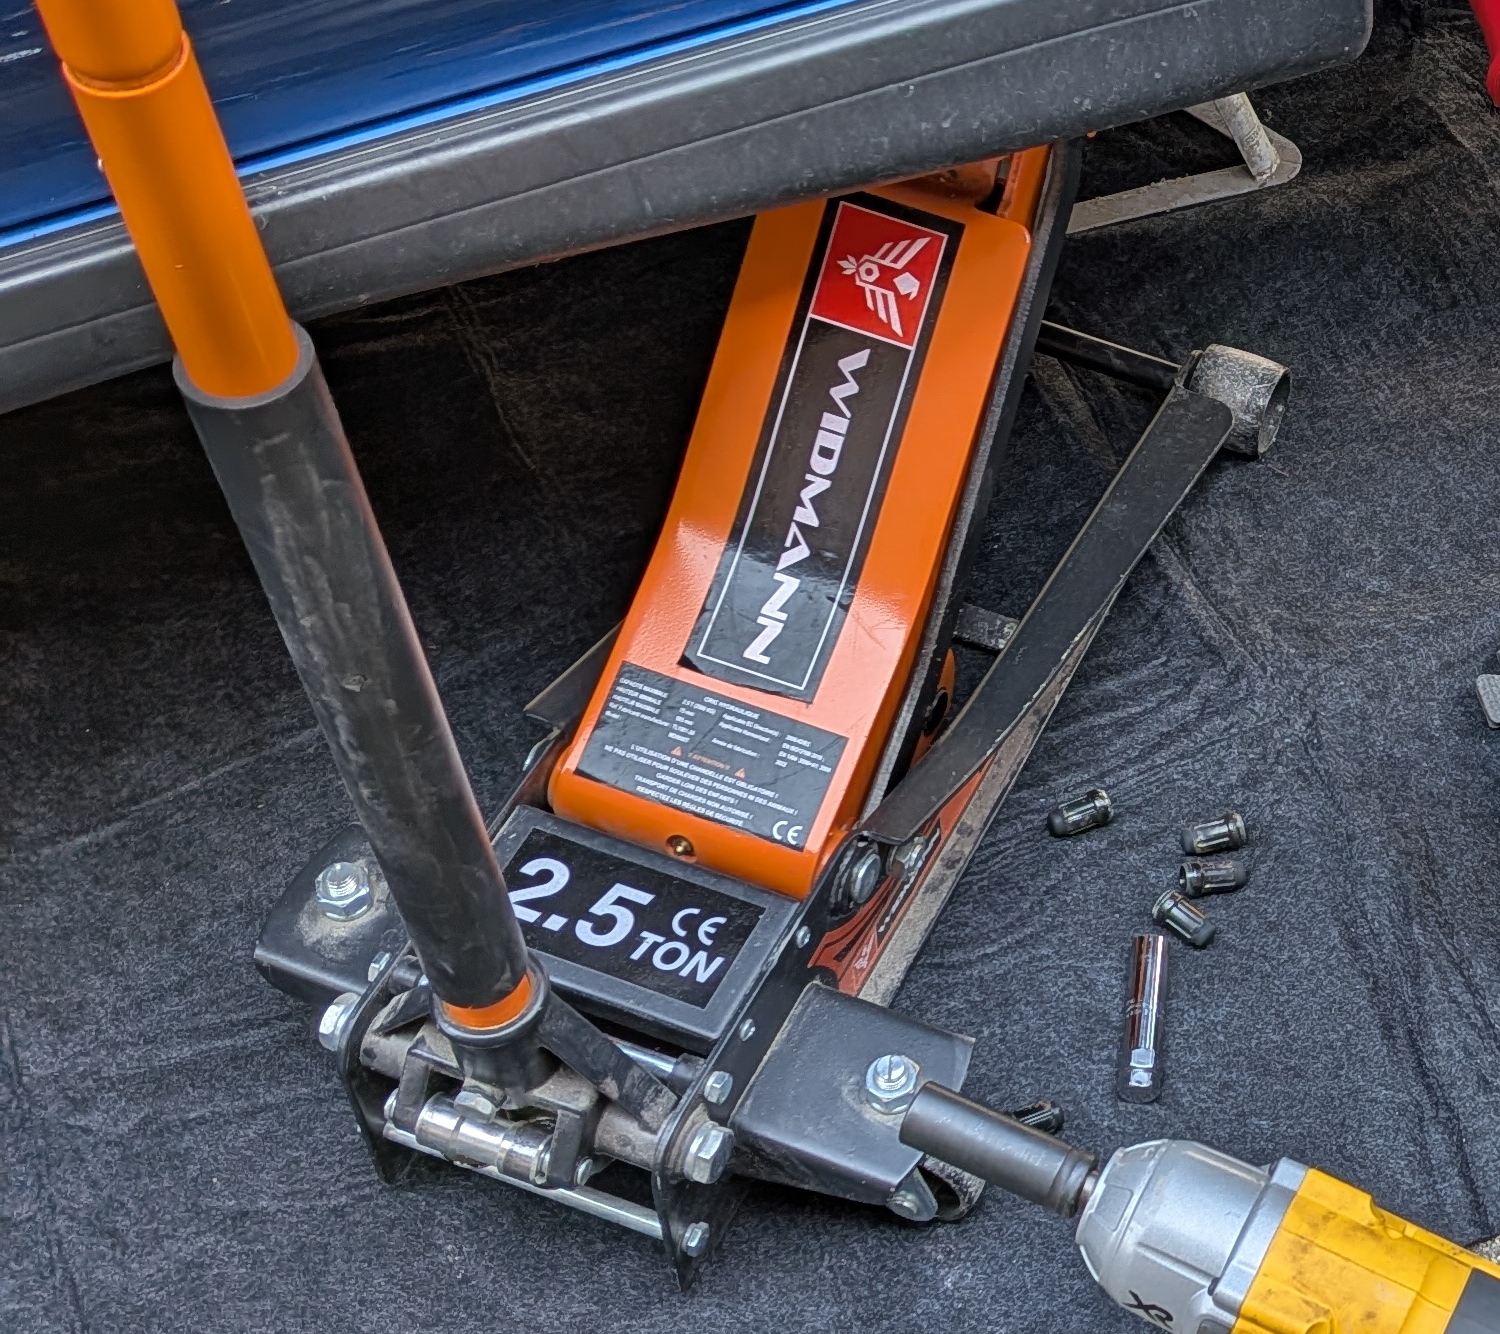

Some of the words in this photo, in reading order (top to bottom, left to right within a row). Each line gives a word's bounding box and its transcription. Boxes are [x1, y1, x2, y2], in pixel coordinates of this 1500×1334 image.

[738, 348, 869, 666] WIDMANN
[772, 820, 803, 845] CE
[504, 857, 656, 948] 2.5
[629, 930, 726, 984] TON
[672, 906, 728, 946] CE
